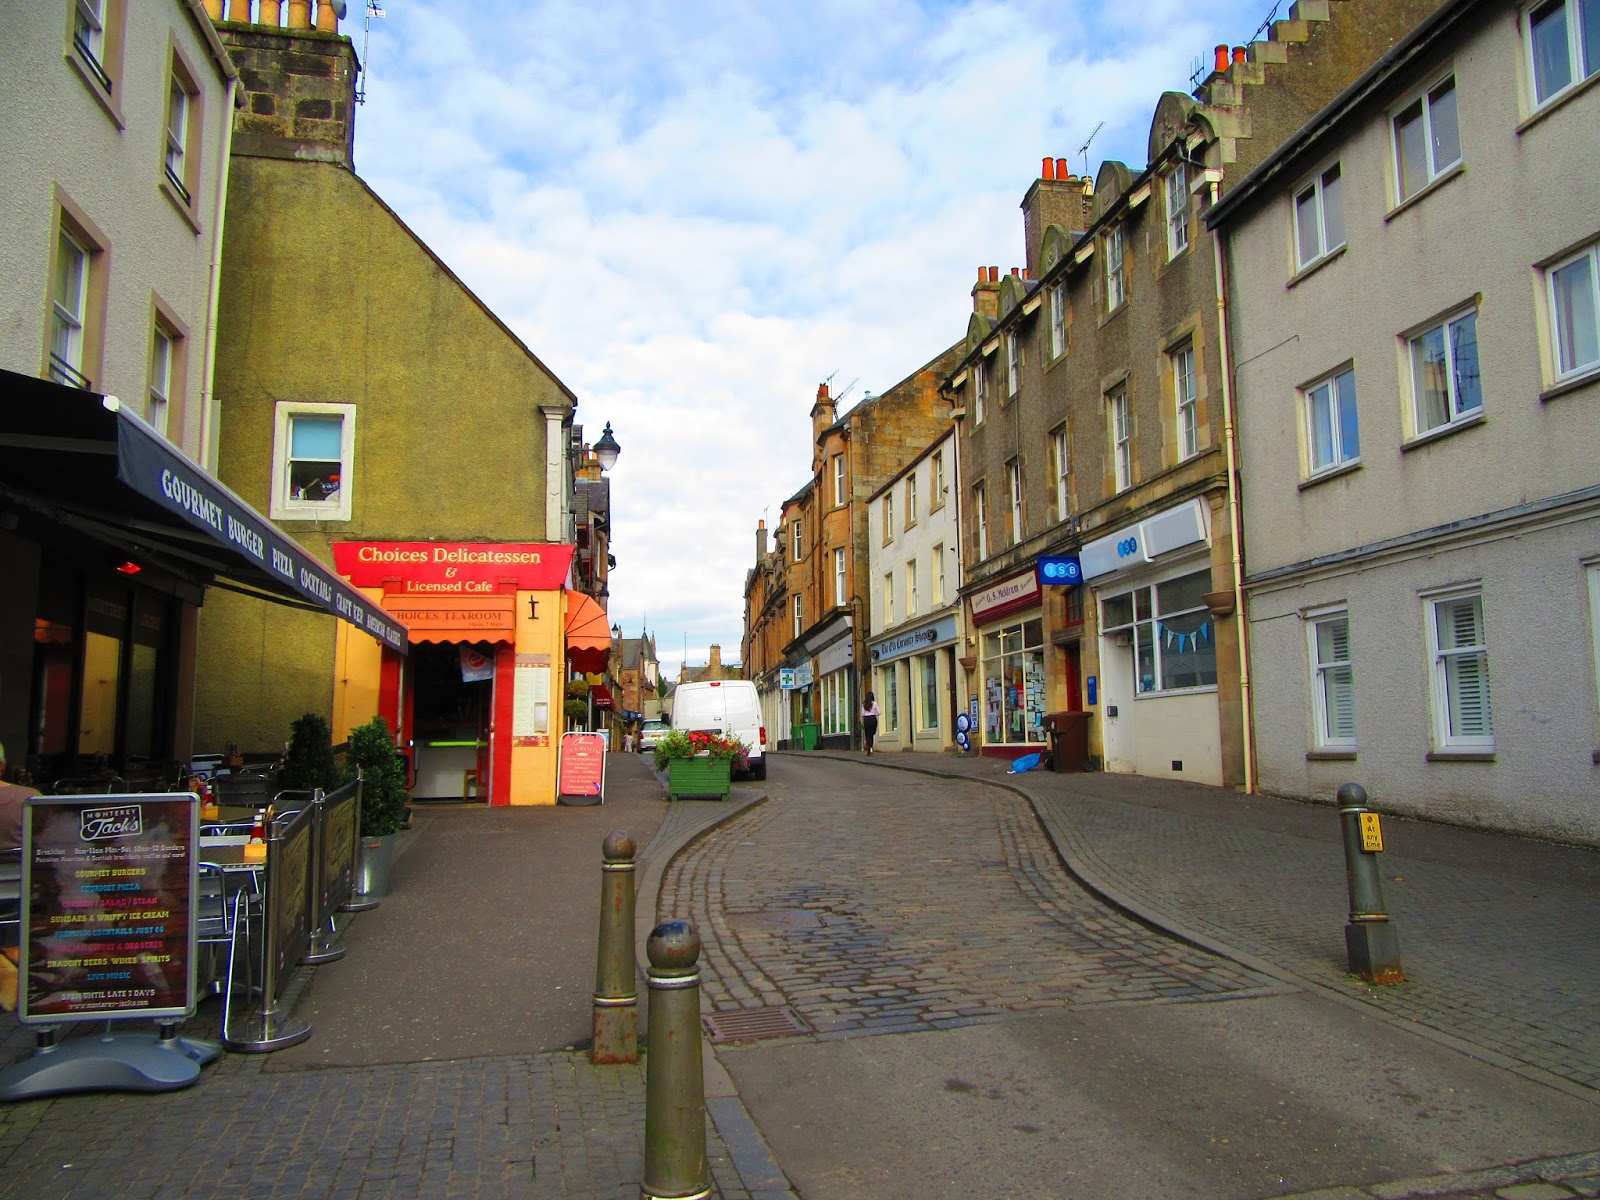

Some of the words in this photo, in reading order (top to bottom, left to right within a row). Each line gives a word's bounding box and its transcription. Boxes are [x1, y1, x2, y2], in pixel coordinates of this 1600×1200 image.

[161, 469, 223, 532] GOURMET
[227, 515, 264, 560] BURGER
[272, 547, 294, 579] PIZZA
[1119, 538, 1136, 557] TSB
[359, 547, 428, 562] Choices
[433, 548, 541, 564] Delicatessen
[445, 566, 457, 577] &
[1046, 564, 1077, 576] TSB
[407, 581, 462, 592] Licensed
[465, 581, 493, 592] Cafe
[445, 612, 502, 620] TEAROOM
[86, 809, 137, 819] MONTEREY
[80, 816, 139, 841] Jack's
[111, 868, 146, 876] BURGERS
[80, 885, 116, 893] GOURMET
[99, 898, 126, 907] SALAD
[132, 897, 157, 905] STEAK
[50, 915, 86, 923] SUNDAES
[97, 913, 128, 921] WHIPPY
[142, 911, 169, 919] CREAM
[134, 927, 153, 935] JUST
[47, 959, 82, 967] DRAUGHT
[141, 955, 170, 963] SPIRITS
[61, 992, 82, 1000] OPEN
[83, 991, 106, 999] UNTIL
[107, 990, 127, 998] LATE
